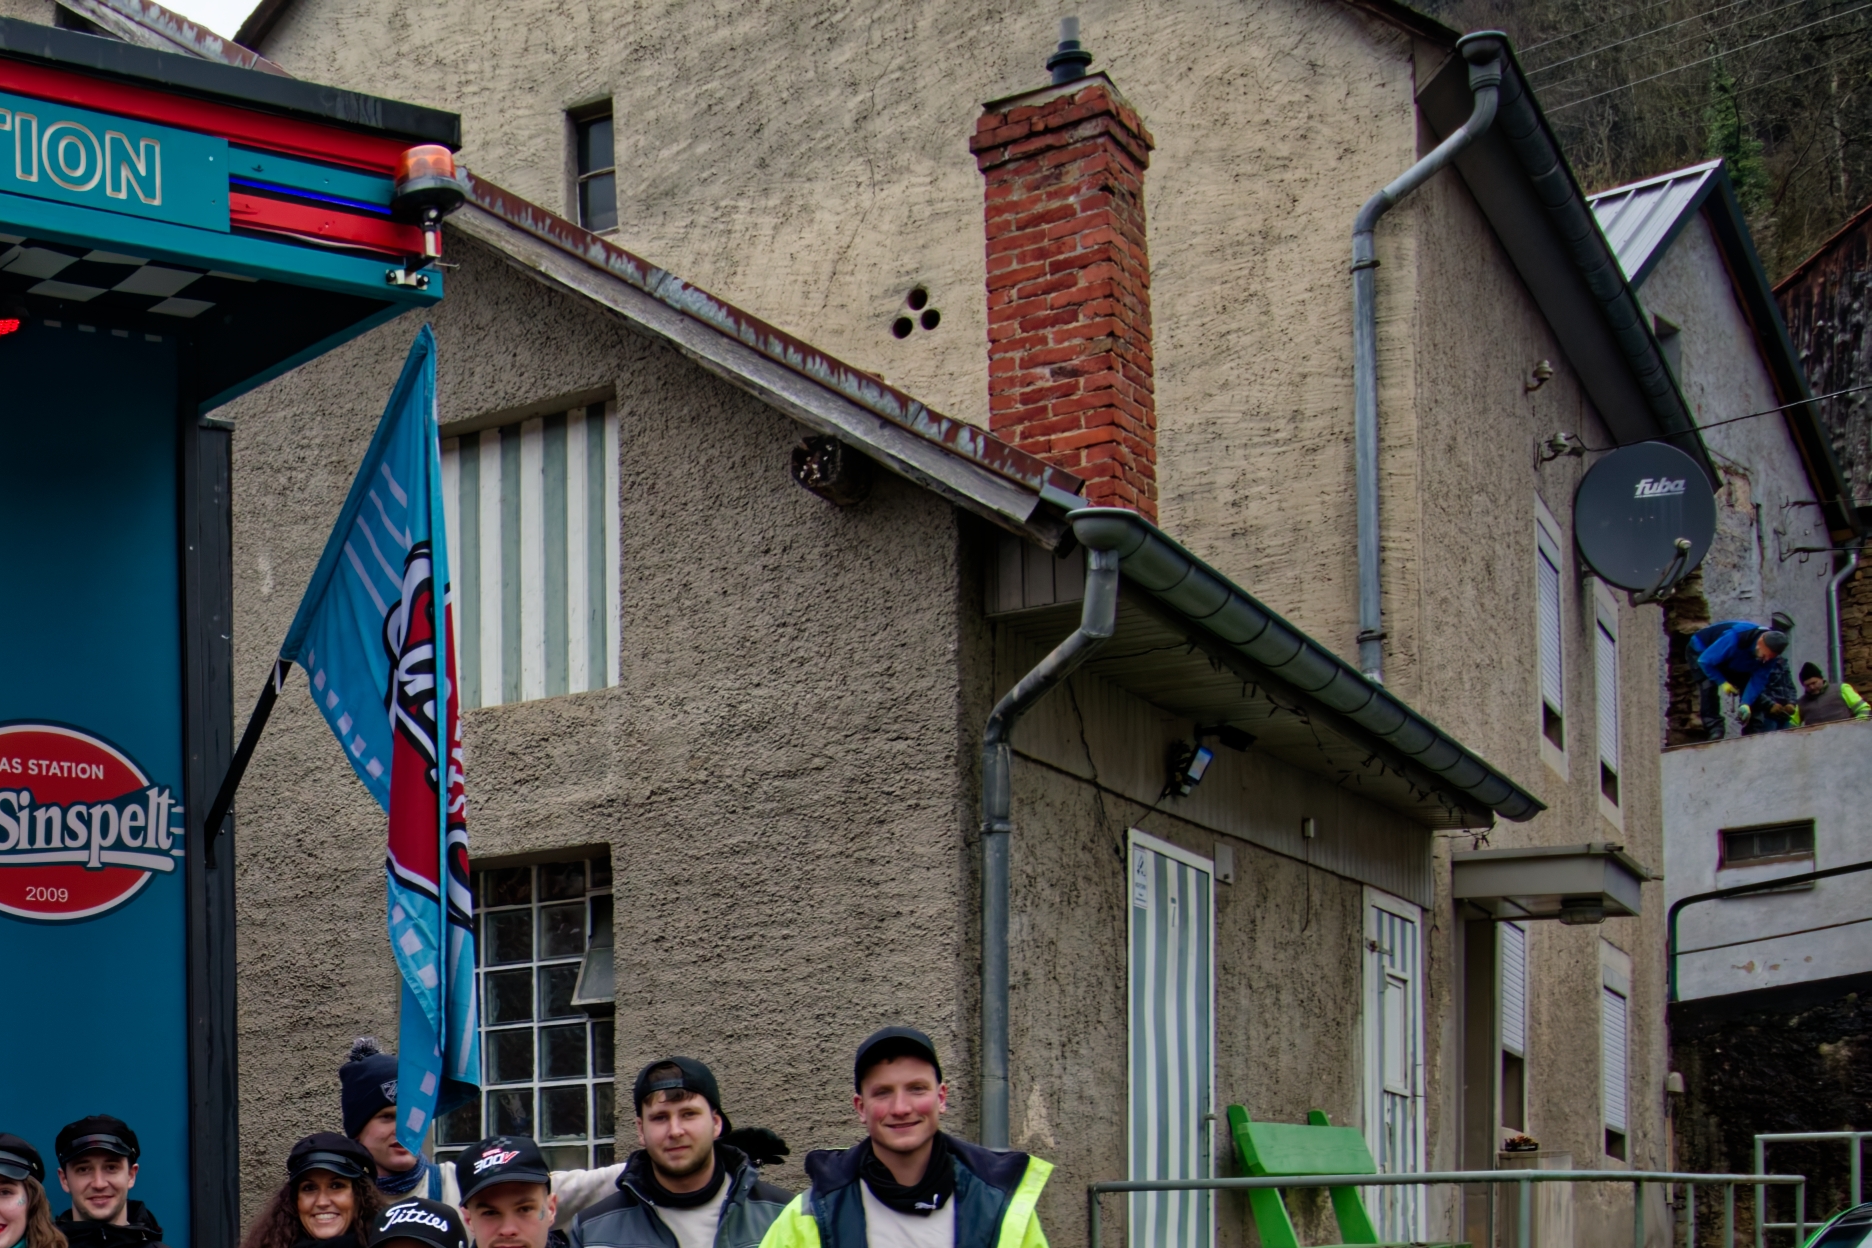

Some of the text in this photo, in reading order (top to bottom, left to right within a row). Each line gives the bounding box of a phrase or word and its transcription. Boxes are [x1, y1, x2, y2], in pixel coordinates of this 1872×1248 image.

[1635, 477, 1686, 496] fuba
[28, 759, 104, 780] STATION
[25, 886, 69, 903] 2009
[473, 1150, 521, 1175] 300V
[379, 1202, 449, 1232] Titties
